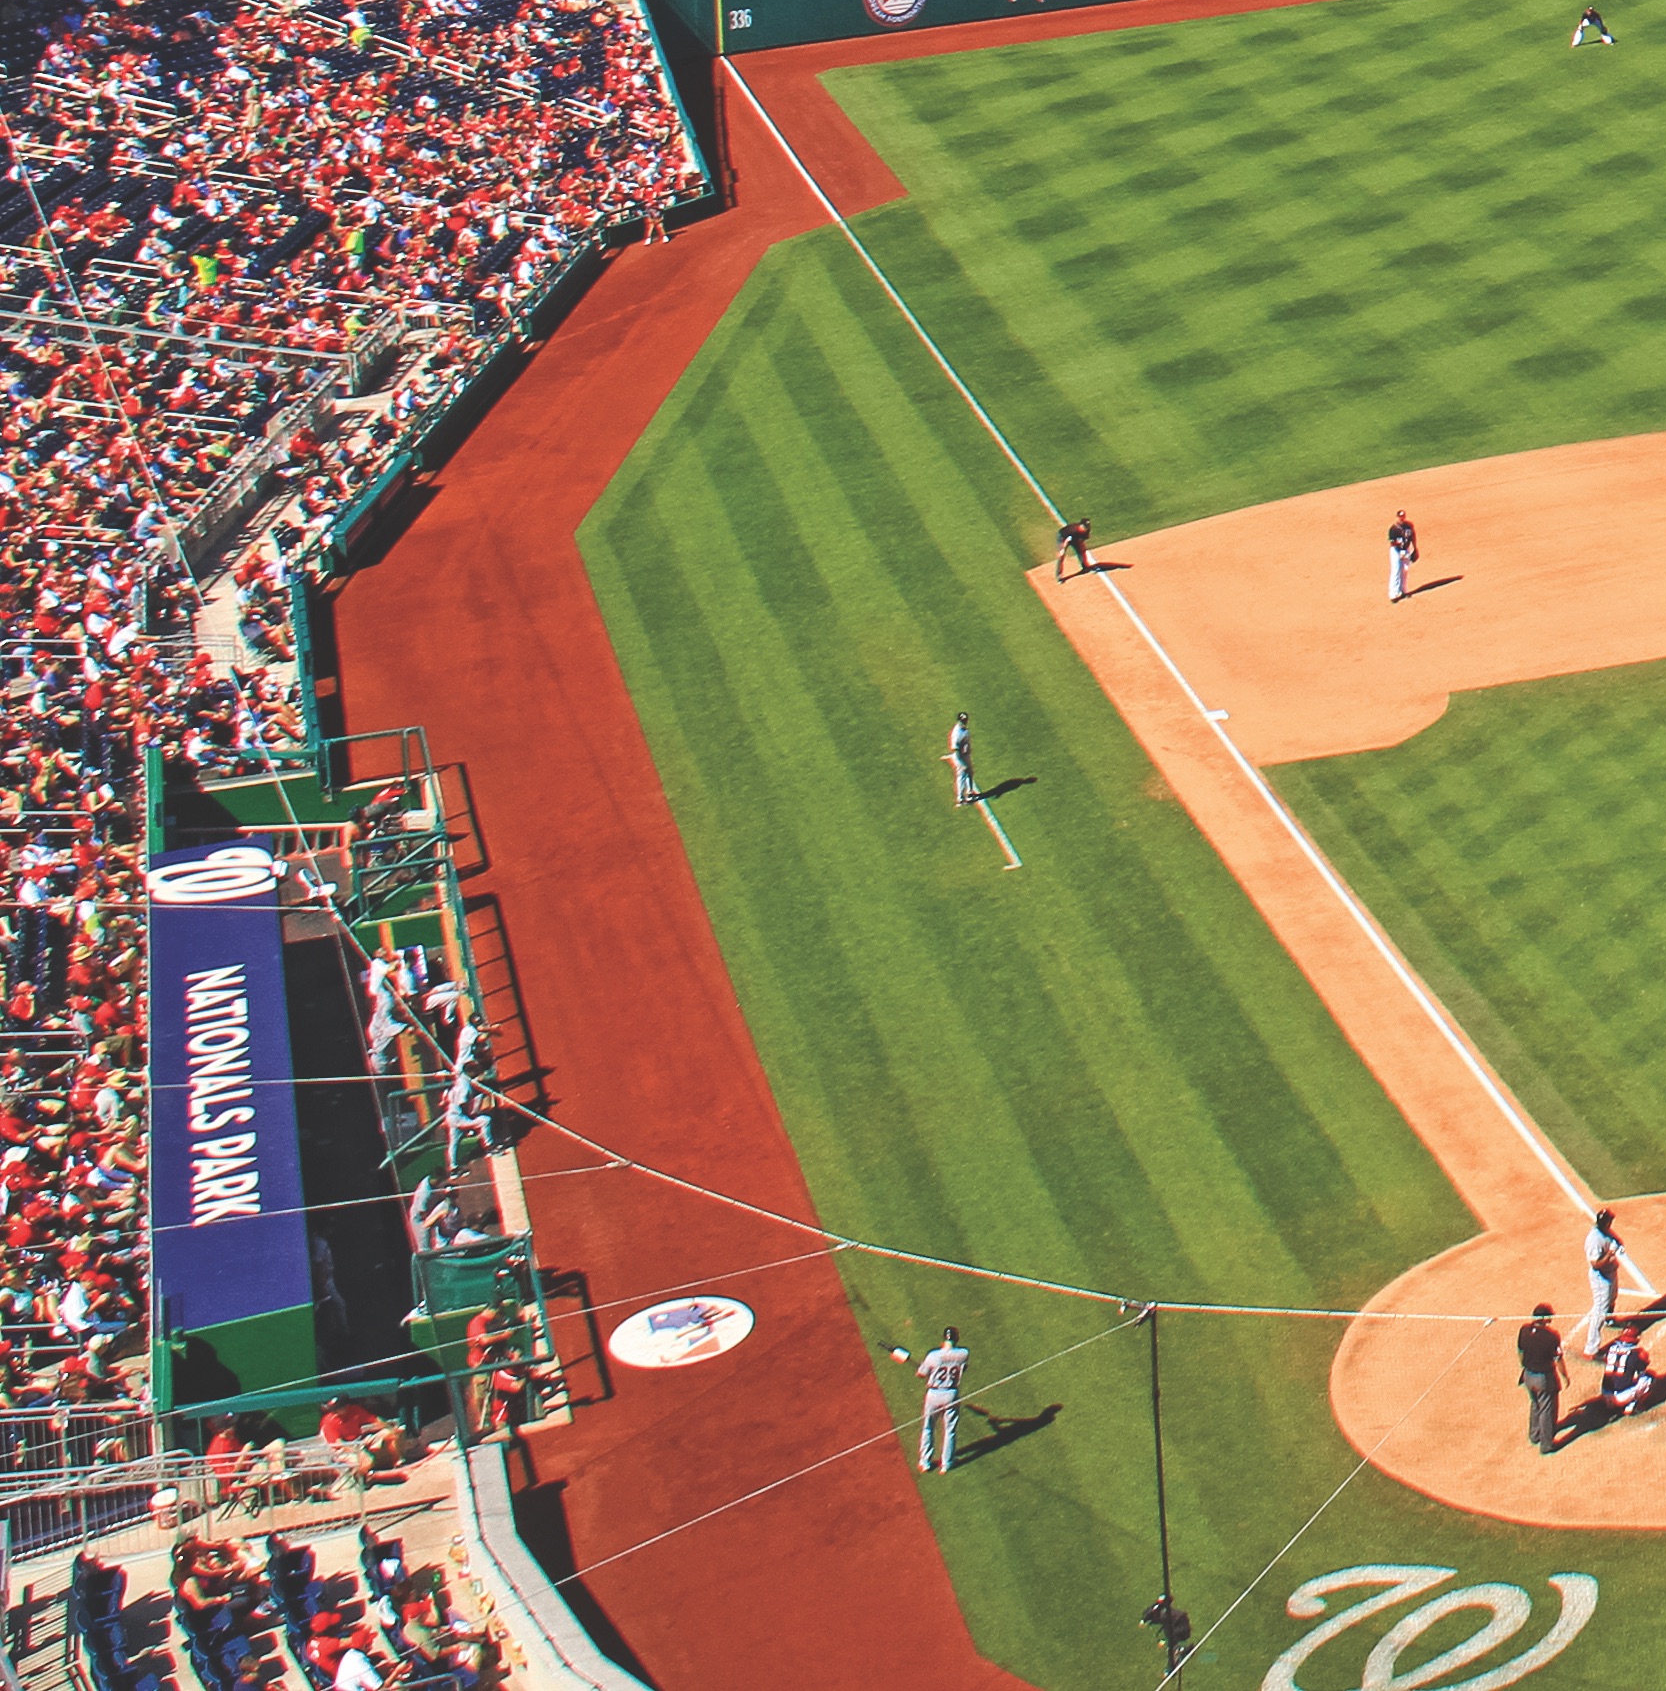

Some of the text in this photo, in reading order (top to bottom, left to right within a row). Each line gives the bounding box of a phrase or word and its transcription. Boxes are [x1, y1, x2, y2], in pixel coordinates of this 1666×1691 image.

[729, 8, 753, 30] 336
[184, 962, 261, 1228] NATIONALS PARK
[938, 1365, 961, 1381] 29
